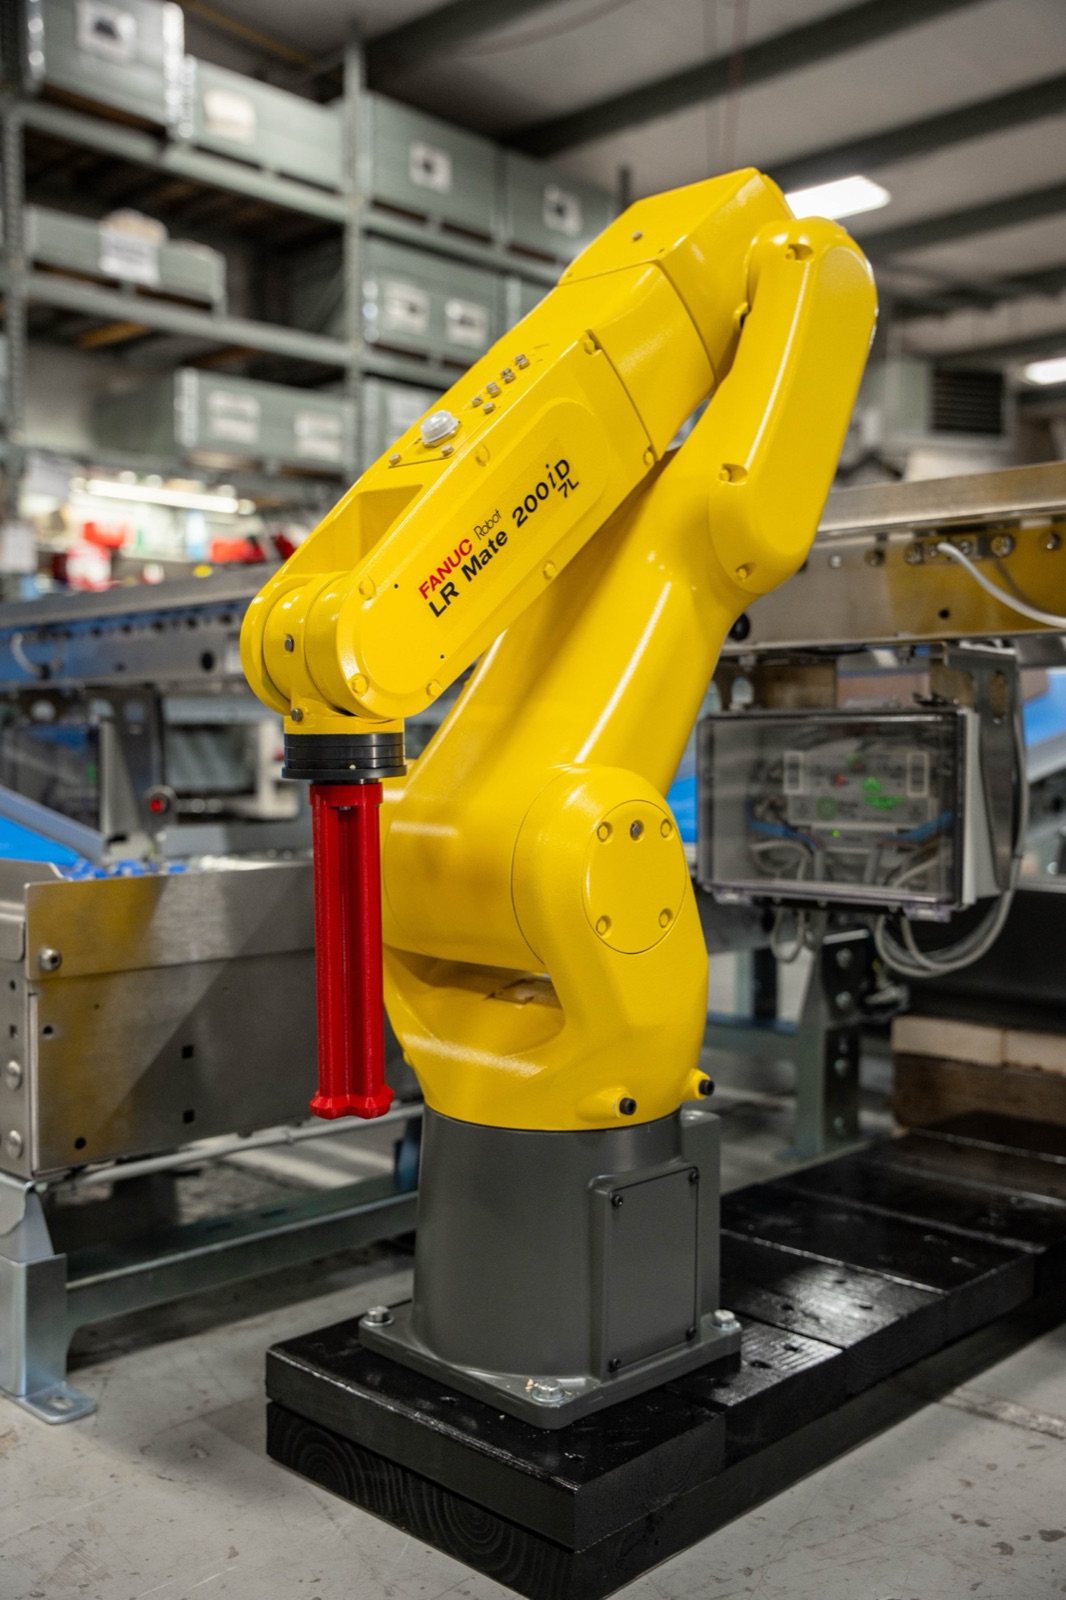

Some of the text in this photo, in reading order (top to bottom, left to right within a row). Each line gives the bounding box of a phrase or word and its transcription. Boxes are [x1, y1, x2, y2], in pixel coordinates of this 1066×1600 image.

[557, 478, 580, 498] 7L
[418, 509, 502, 600] FANUC Robot
[428, 459, 570, 618] LR Mate 200iD
